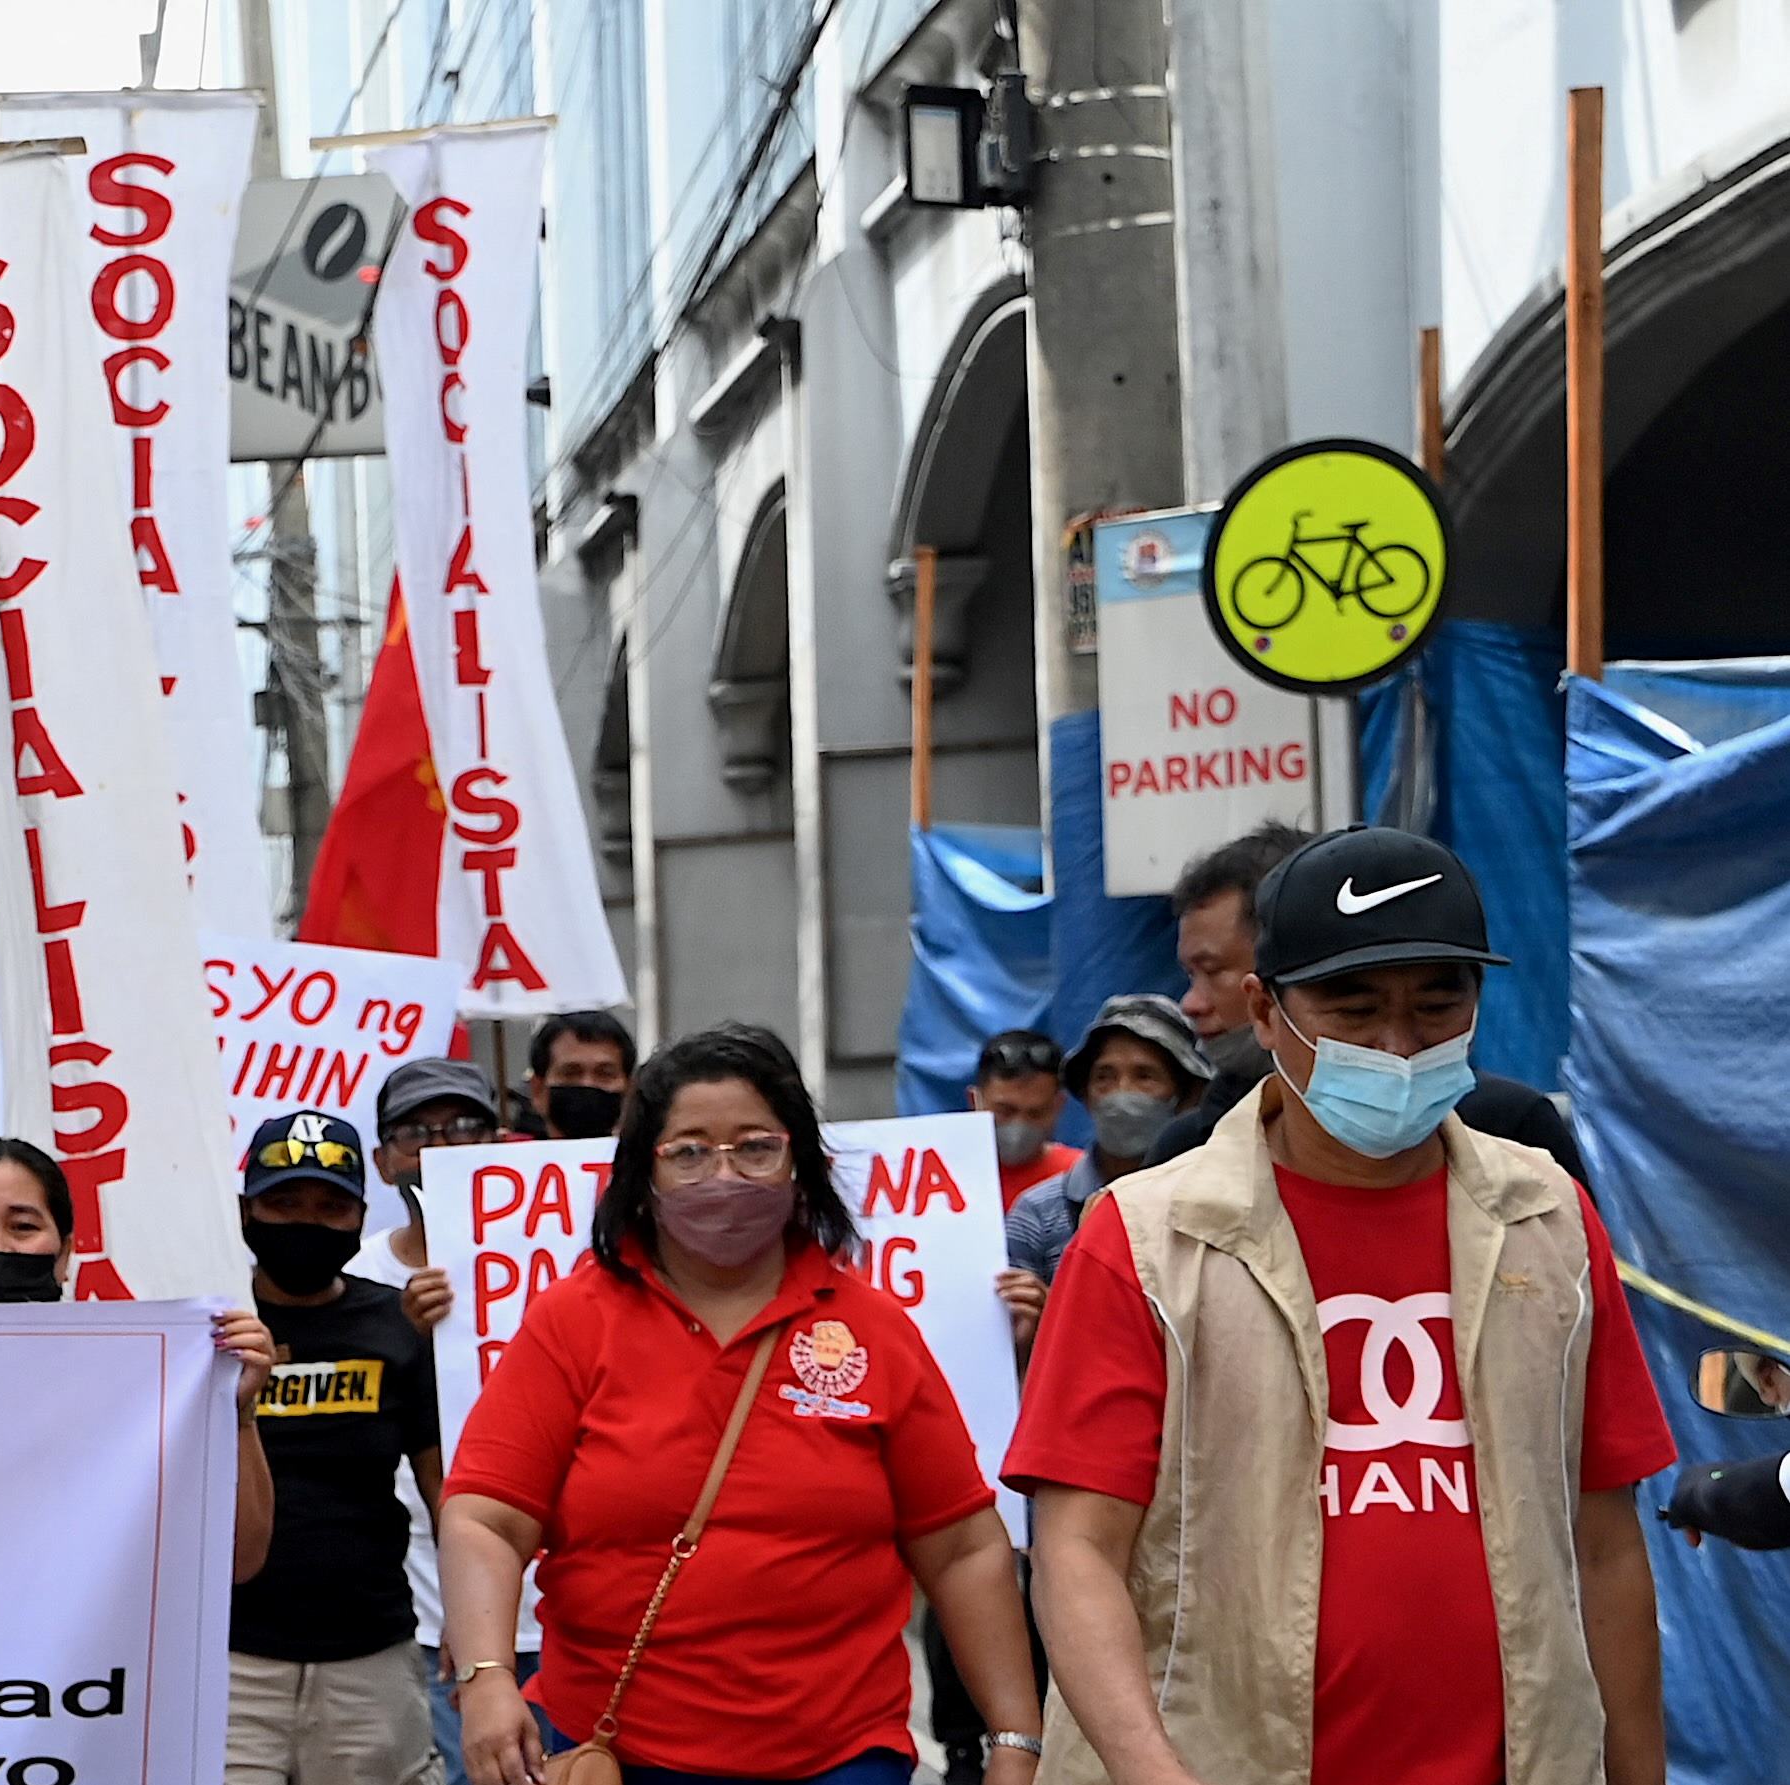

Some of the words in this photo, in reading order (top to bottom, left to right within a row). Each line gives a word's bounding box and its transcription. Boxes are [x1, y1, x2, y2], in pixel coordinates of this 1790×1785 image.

[86, 152, 179, 693] SOCIA
[411, 197, 547, 991] SOCIALISTA
[1168, 686, 1239, 734] NO
[1106, 740, 1308, 802] PARKING
[204, 958, 338, 1027] SYO
[357, 998, 424, 1058] ng
[218, 1036, 370, 1108] IHIN
[864, 1148, 967, 1217] NA
[475, 1248, 590, 1337] PA
[259, 1370, 373, 1407] RGIVEN.
[1319, 1456, 1471, 1517] HAN
